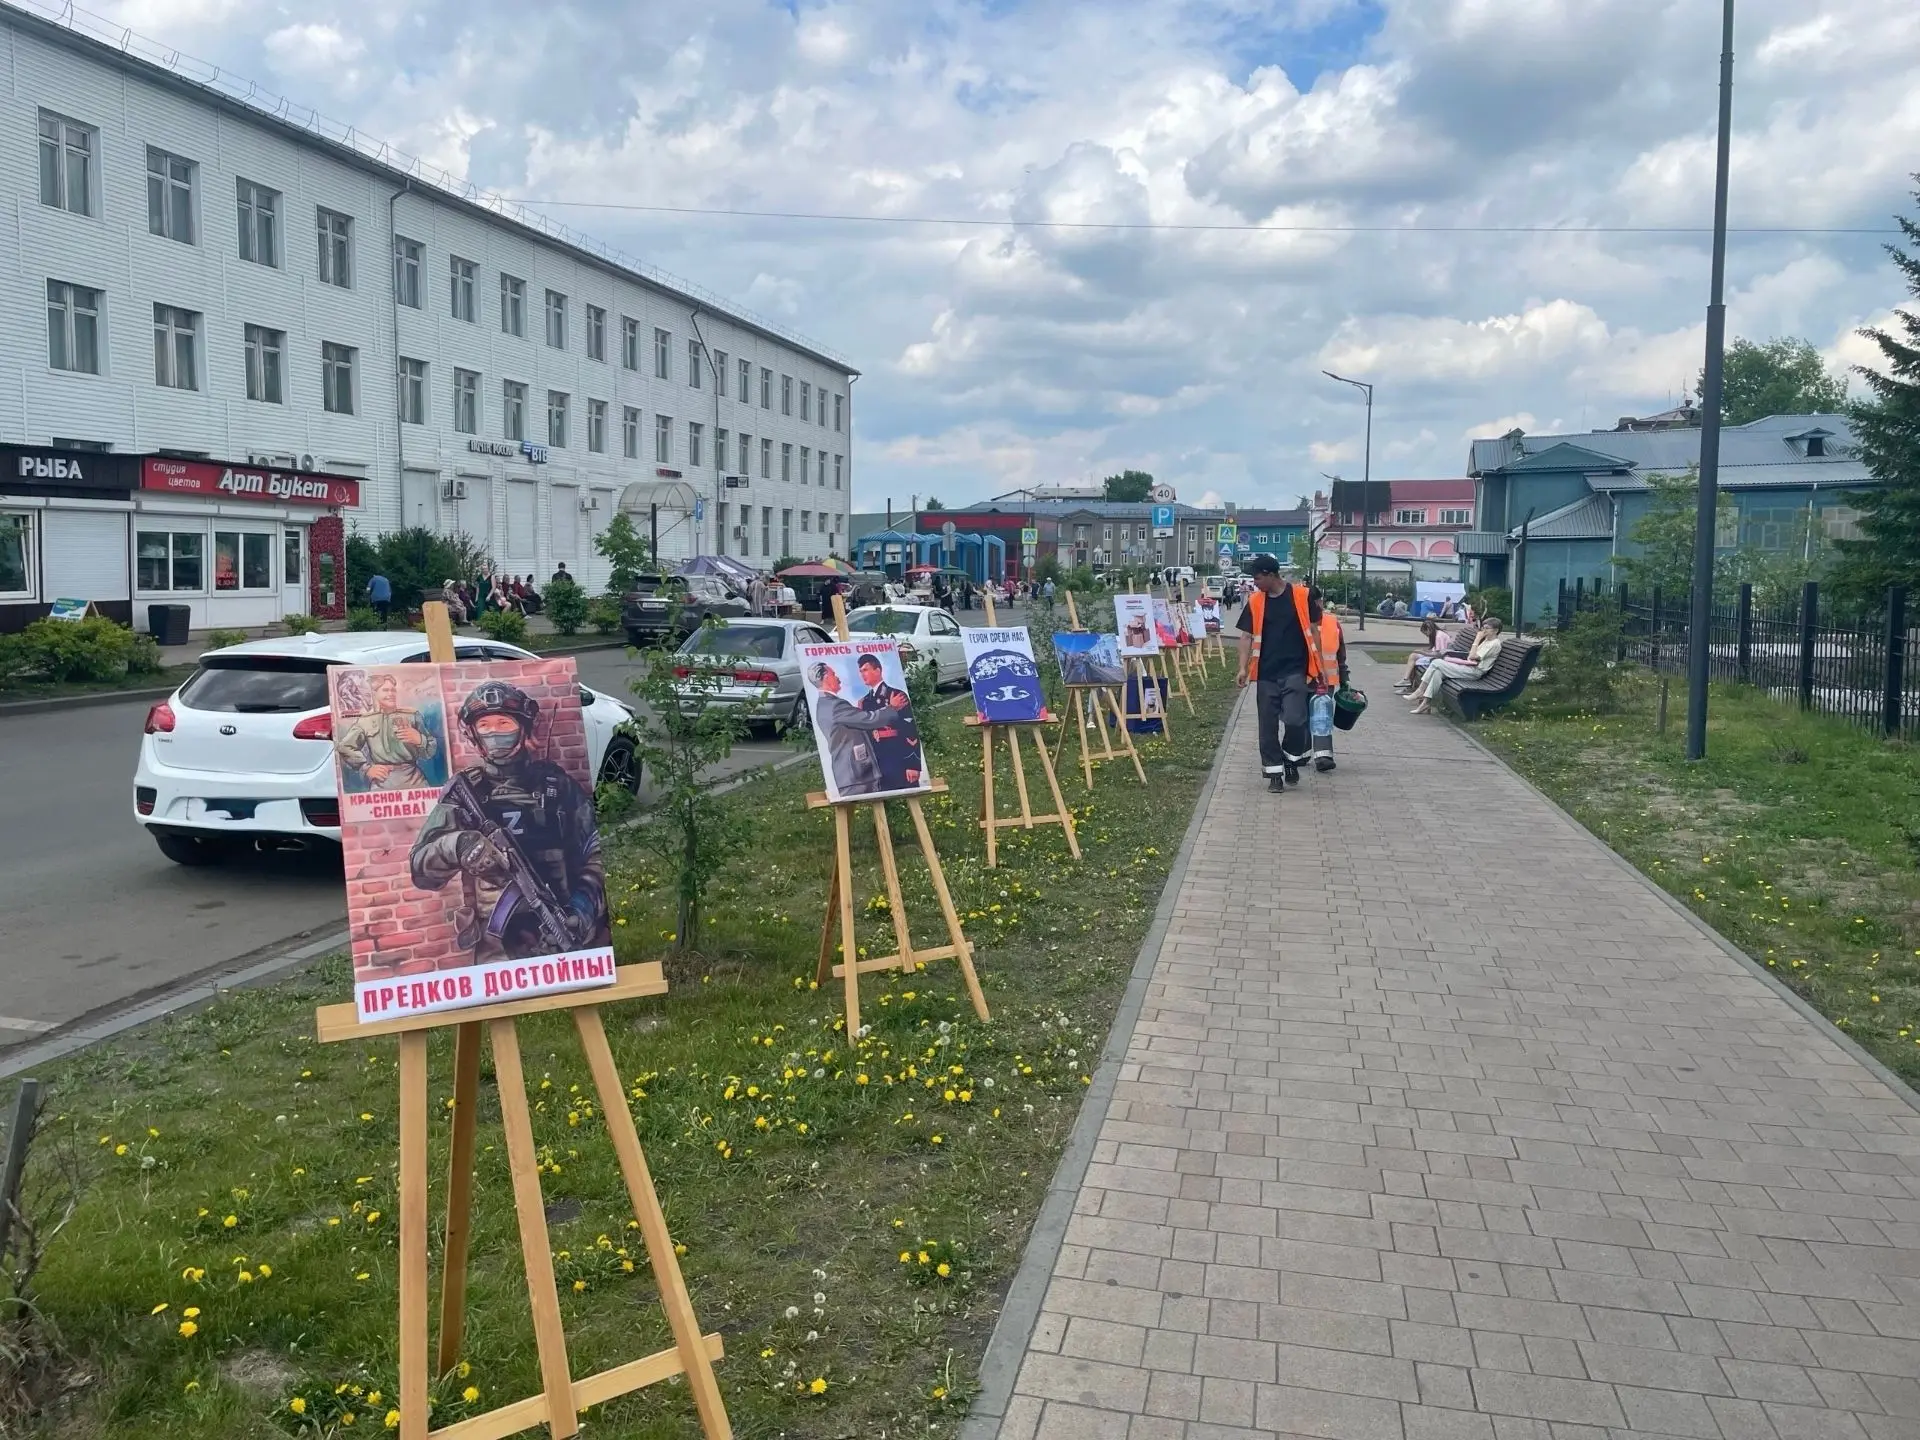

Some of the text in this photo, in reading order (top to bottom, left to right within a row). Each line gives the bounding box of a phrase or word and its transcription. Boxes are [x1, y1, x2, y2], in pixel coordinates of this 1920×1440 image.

[470, 440, 492, 453] ПОЧТА
[531, 446, 547, 463] ВТБ
[19, 456, 83, 480] РЫБА
[152, 462, 187, 475] студия
[168, 476, 201, 489] цветов
[219, 468, 329, 499] Арт Букет
[1157, 489, 1170, 498] 40
[1158, 507, 1170, 525] P
[969, 631, 1025, 644] ГЕРОИ СРЕДИ НАС
[804, 641, 896, 657] ГОРЖУСЬ СЫНОМ!
[221, 726, 235, 735] KIA
[350, 790, 403, 806] КРАСНОЙ
[502, 811, 524, 834] Z
[363, 954, 614, 1014] ПРЕДКОВ ДОСТОЙНЫ!
